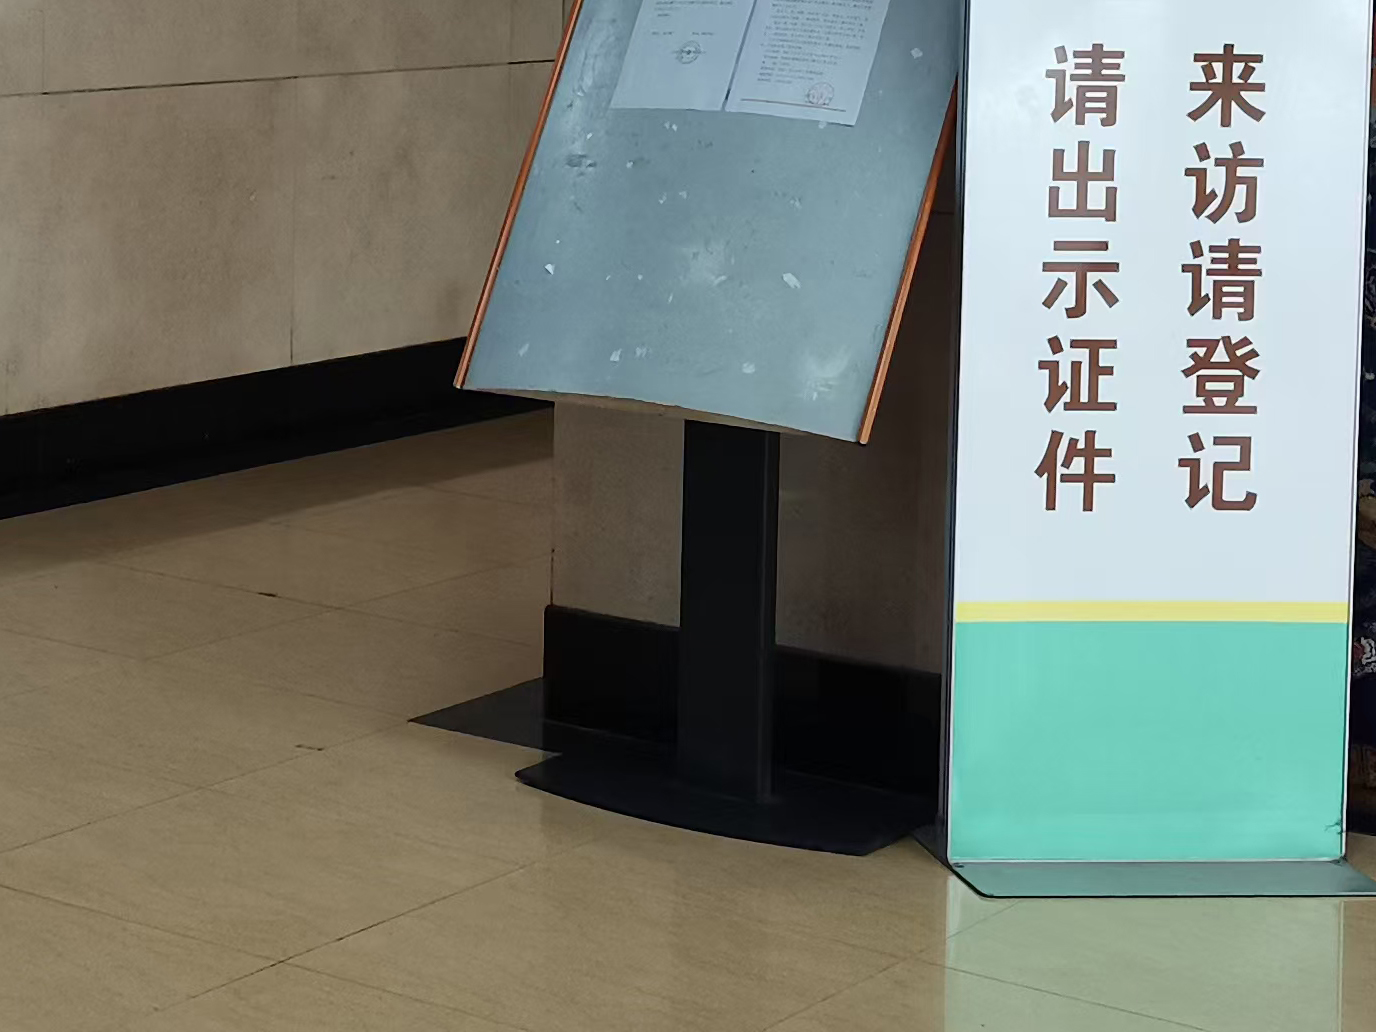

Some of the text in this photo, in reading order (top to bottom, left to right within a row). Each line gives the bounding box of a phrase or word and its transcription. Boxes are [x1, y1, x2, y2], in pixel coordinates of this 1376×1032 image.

[1034, 43, 1126, 512] 请出示证件
[1177, 43, 1266, 512] 来访请登记
